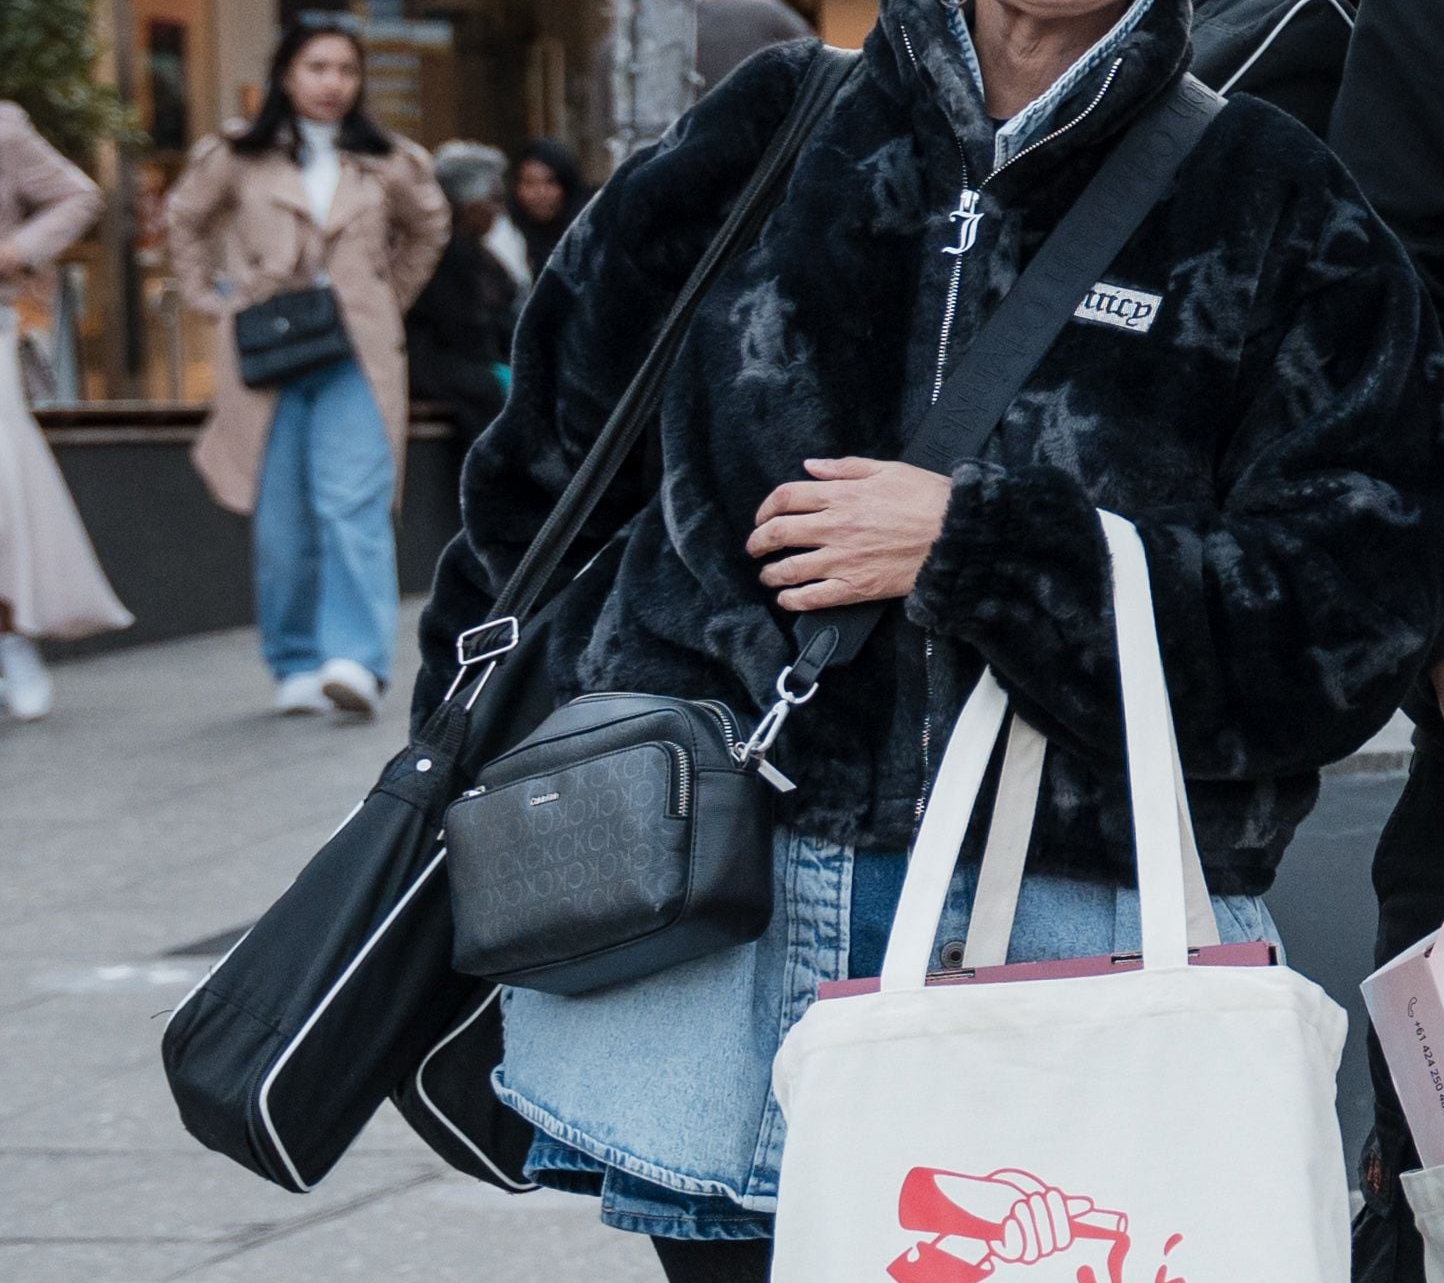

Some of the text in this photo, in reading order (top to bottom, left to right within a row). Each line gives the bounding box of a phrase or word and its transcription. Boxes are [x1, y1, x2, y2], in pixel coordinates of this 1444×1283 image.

[1082, 290, 1153, 327] uicy
[1414, 1020, 1427, 1042] +61
[1422, 1044, 1435, 1068] 424
[1429, 1069, 1444, 1092] 250
